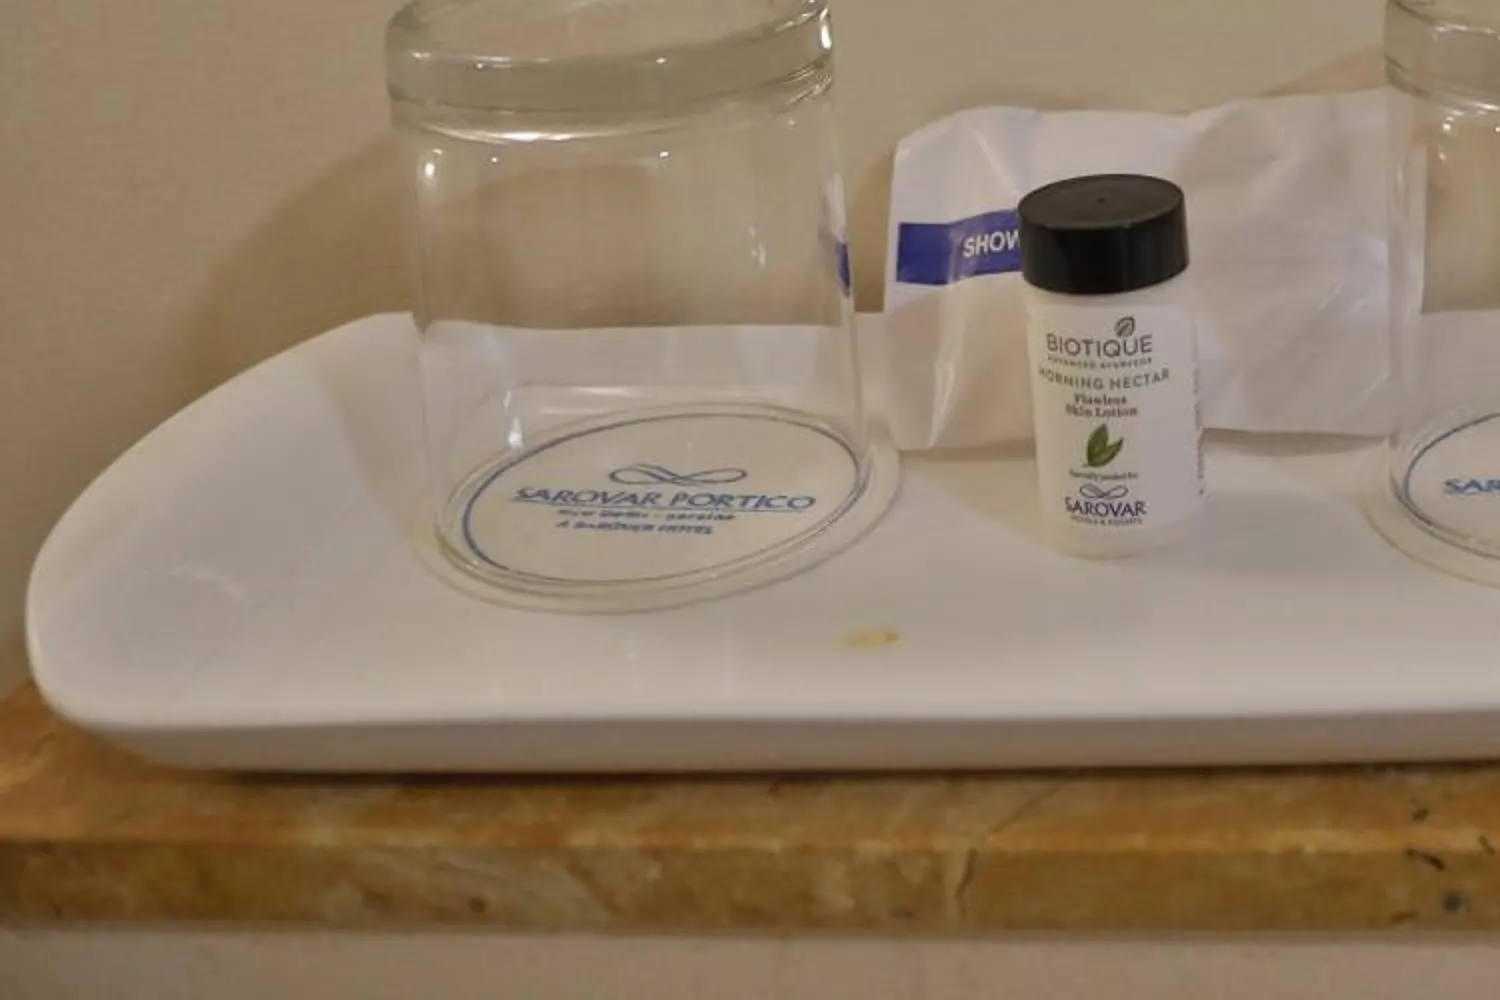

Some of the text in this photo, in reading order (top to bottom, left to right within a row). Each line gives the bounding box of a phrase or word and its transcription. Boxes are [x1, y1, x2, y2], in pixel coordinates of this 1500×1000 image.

[1047, 335, 1153, 357] BIOTIQUE
[1109, 368, 1170, 390] NECTAR
[514, 487, 817, 510] SAROVAR PORTICO
[1064, 496, 1147, 518] SAROVAR
